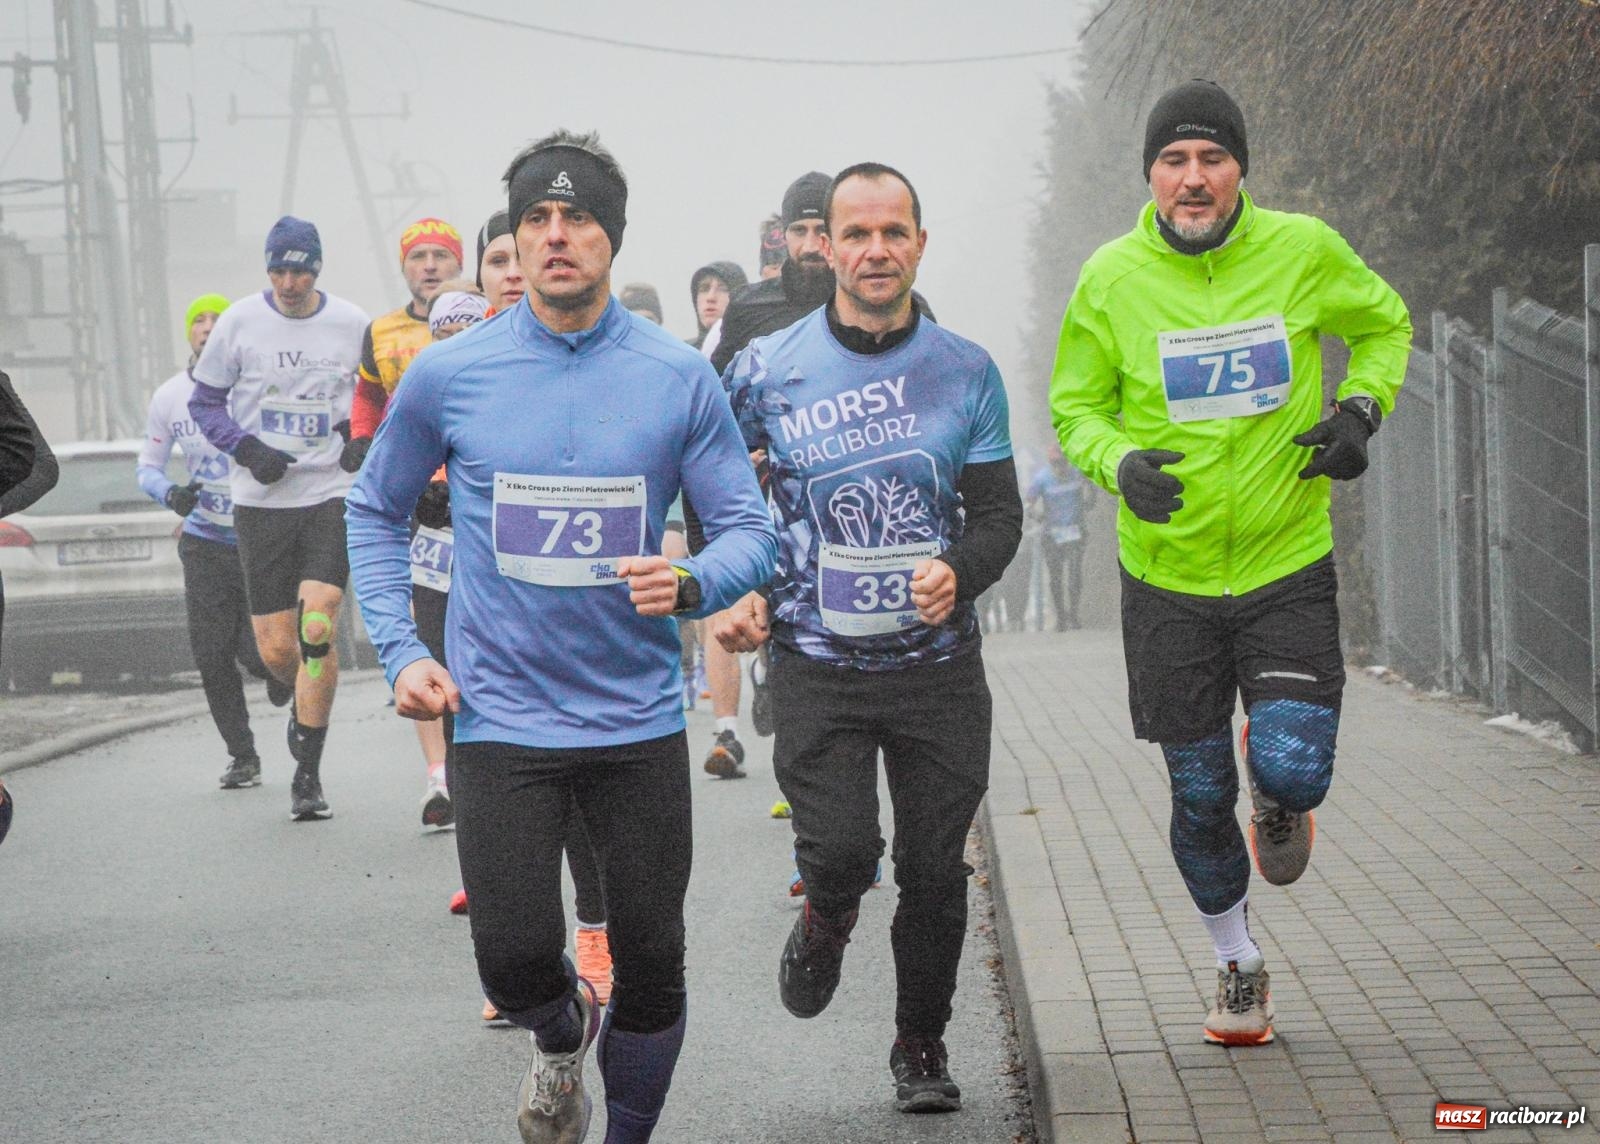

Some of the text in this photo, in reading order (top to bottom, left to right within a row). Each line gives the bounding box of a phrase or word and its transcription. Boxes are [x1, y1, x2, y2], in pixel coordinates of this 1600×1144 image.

[1206, 334, 1214, 342] po
[1215, 331, 1234, 340] Ziemi
[1234, 323, 1275, 337] Pietrowickiej
[278, 351, 303, 368] IV
[1198, 350, 1256, 394] 75
[274, 412, 319, 436] 118
[779, 376, 906, 444] MORSY
[172, 420, 197, 438] RU
[790, 413, 921, 470] RACIBÓRZ
[528, 484, 550, 492] Cross
[586, 485, 635, 494] Pietrowickiej
[537, 510, 603, 555] 73
[411, 537, 442, 569] 34
[892, 550, 933, 559] Pietrowickiej
[853, 573, 907, 611] 33
